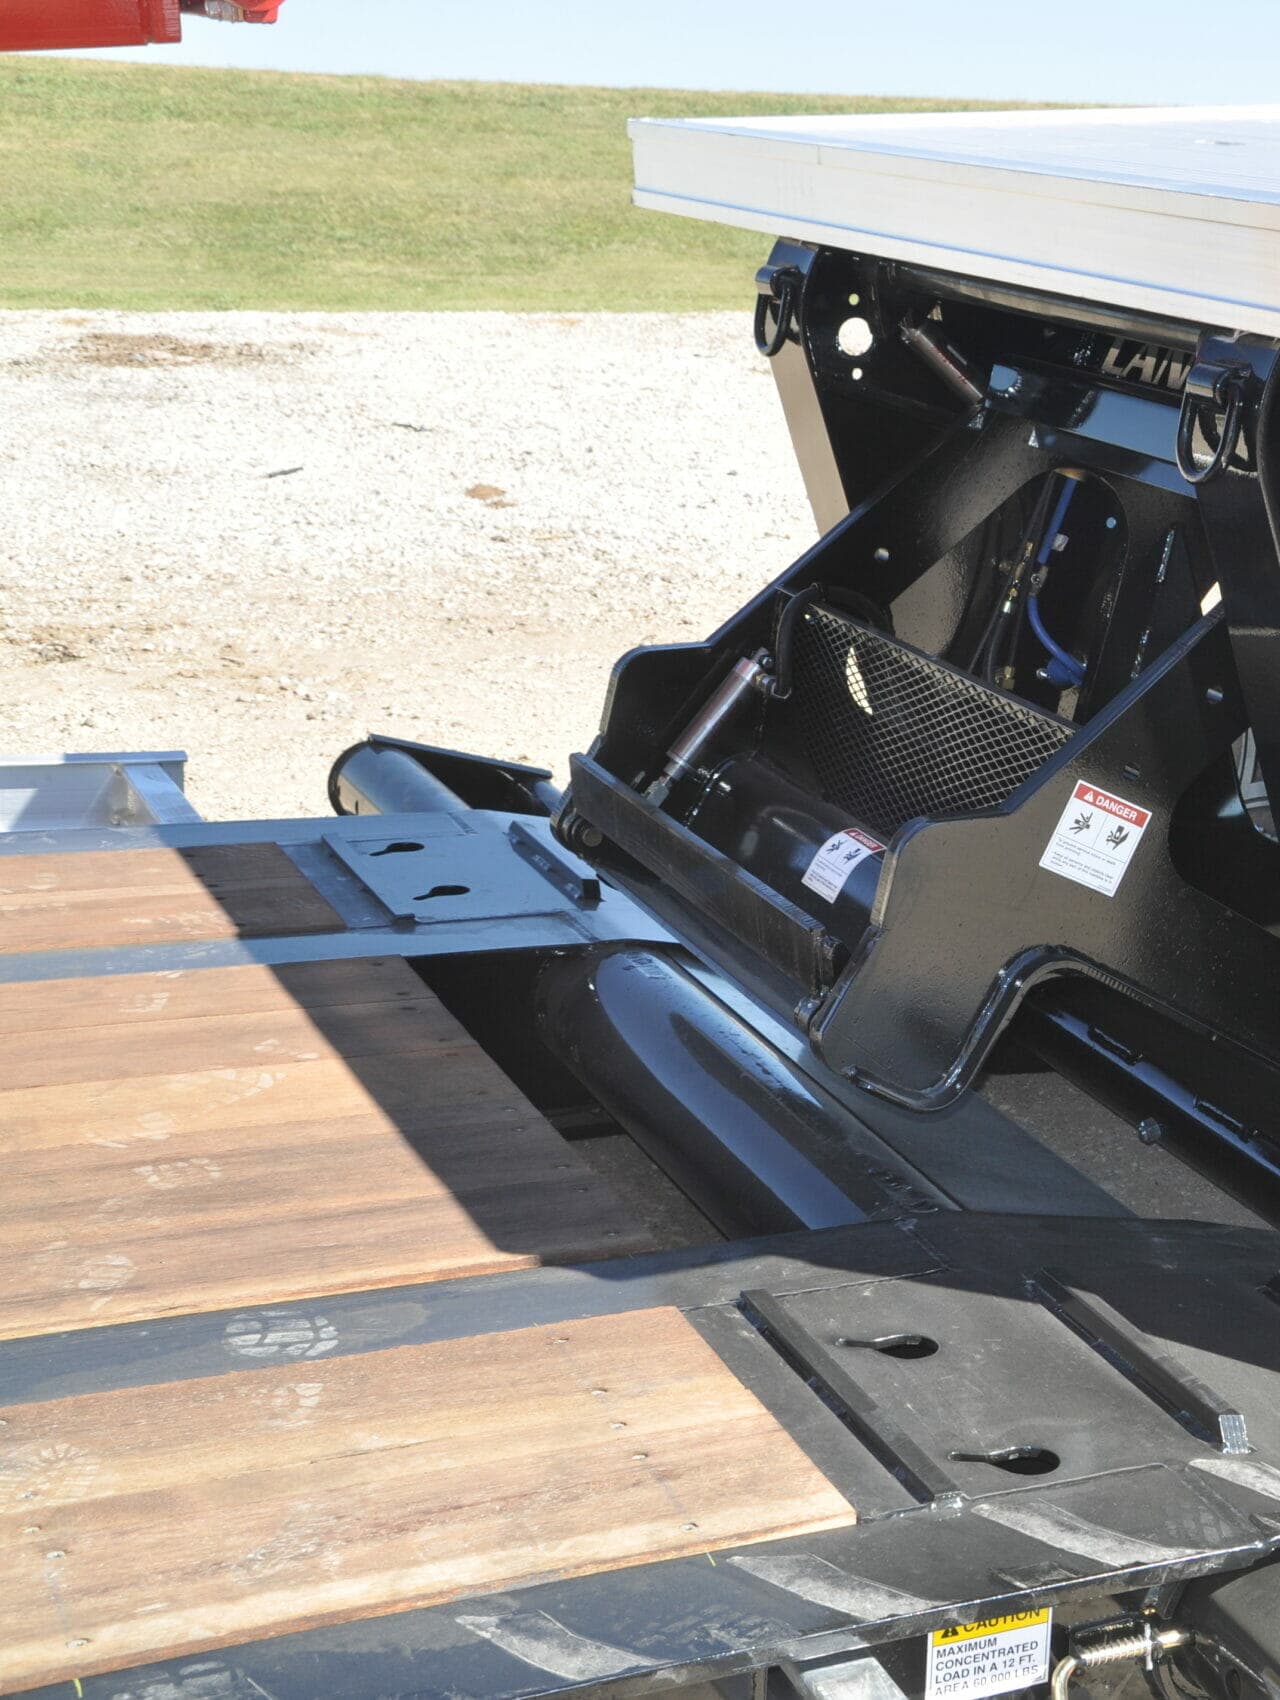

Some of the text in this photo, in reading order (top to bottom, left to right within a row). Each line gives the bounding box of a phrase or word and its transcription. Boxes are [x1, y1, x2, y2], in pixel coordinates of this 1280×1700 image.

[1095, 795, 1138, 821] DANGER
[935, 1640, 1039, 1672] CONCENTRATED
[936, 1637, 998, 1659] MAXIMUM
[935, 1653, 1036, 1684] LOAD IN A 12 FT.
[935, 1681, 969, 1696] AREA
